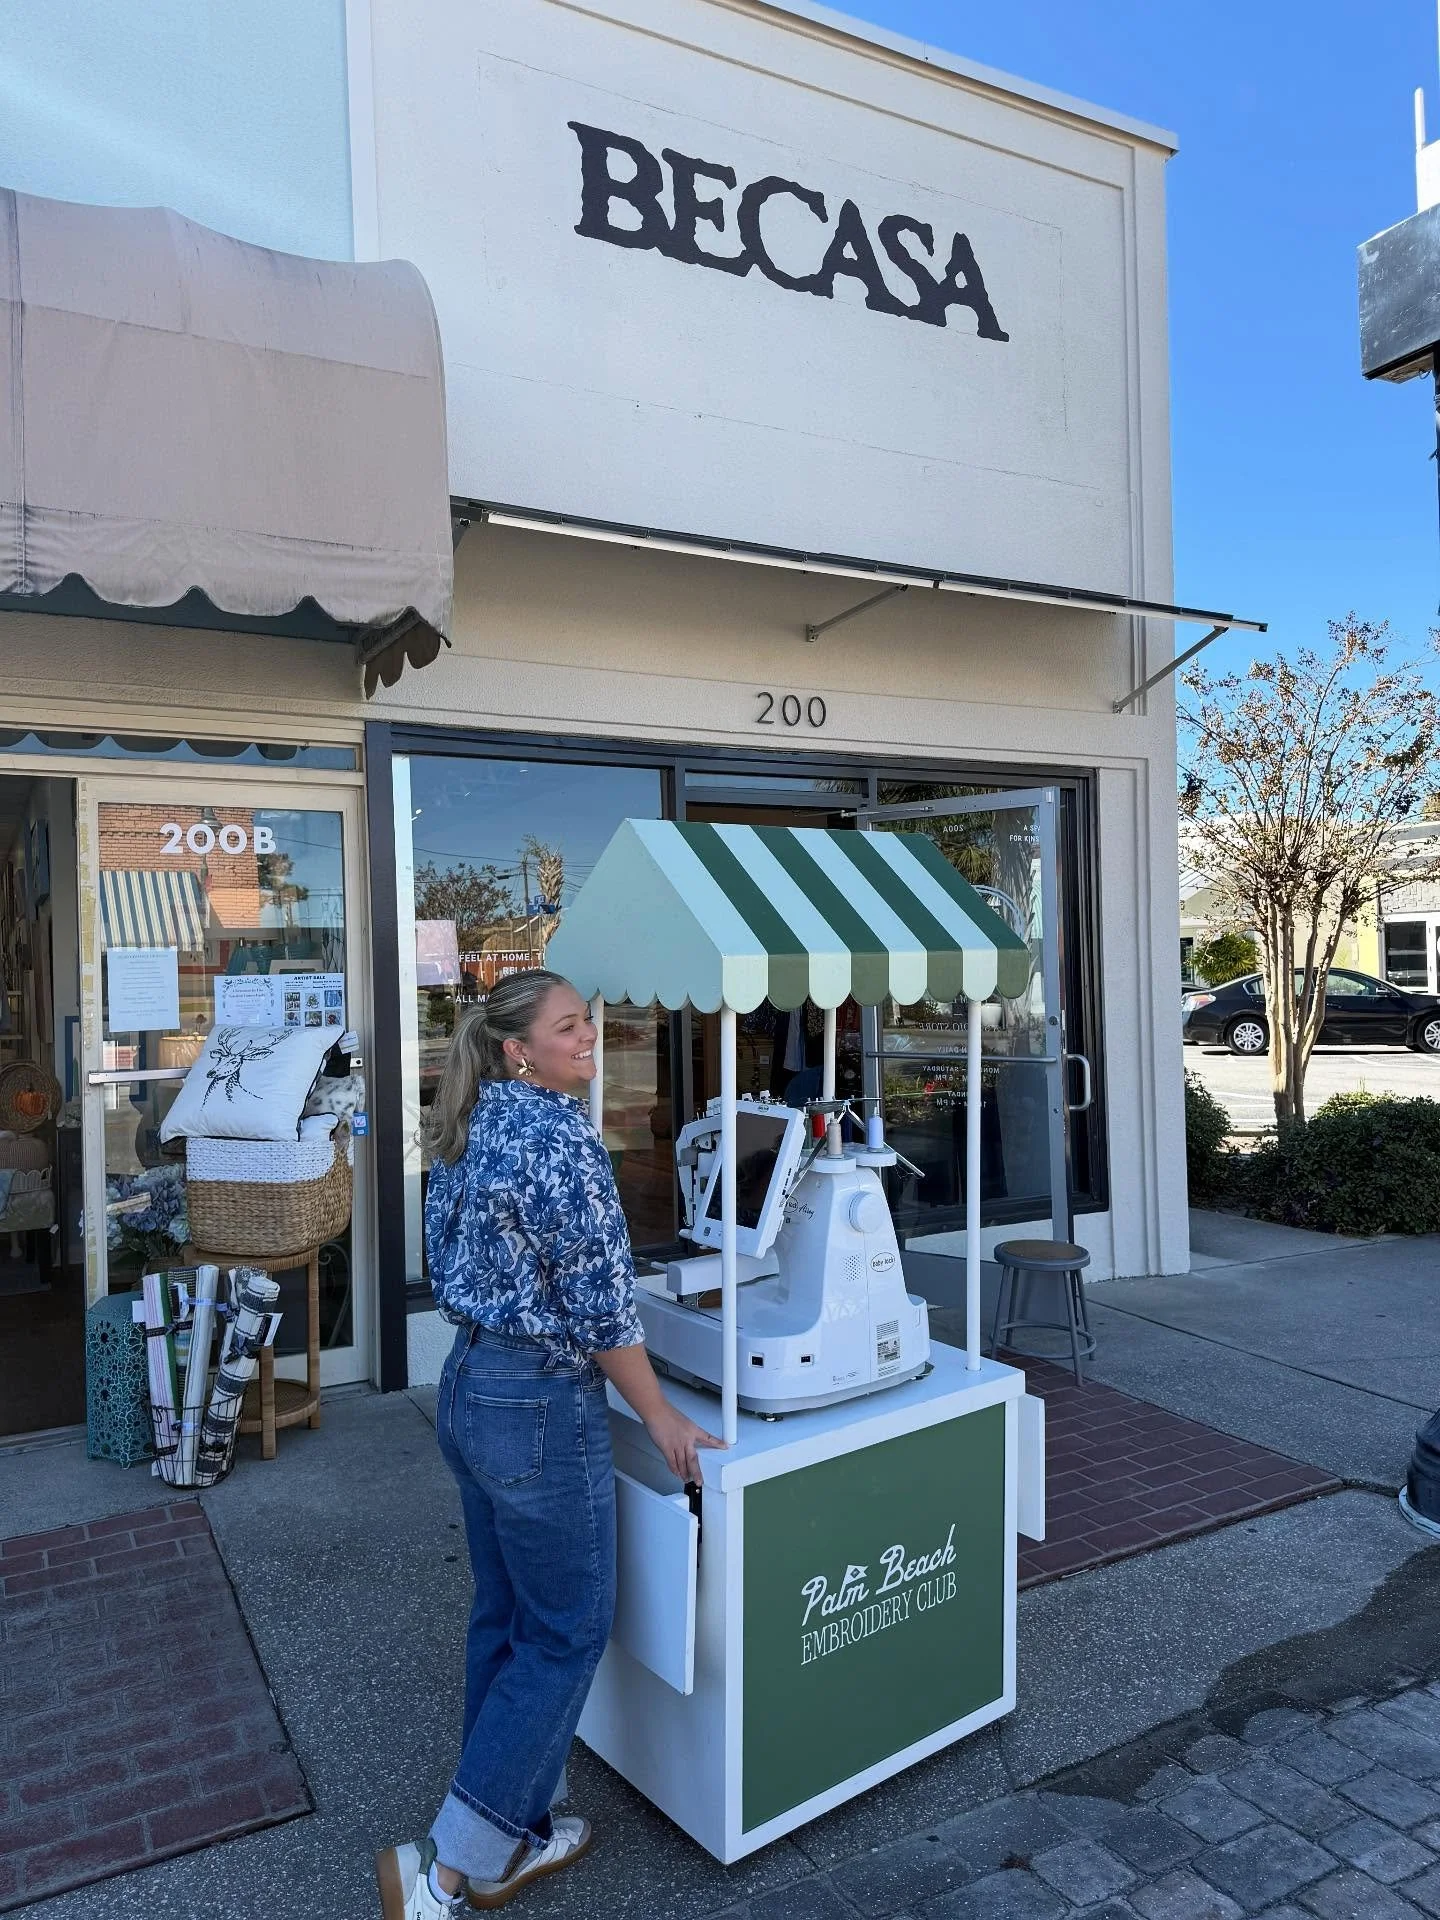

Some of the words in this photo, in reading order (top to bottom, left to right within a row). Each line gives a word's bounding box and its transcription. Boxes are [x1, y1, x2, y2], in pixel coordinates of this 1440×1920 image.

[567, 120, 1009, 342] BECASA
[755, 691, 827, 727] 200
[159, 822, 277, 854] 200B
[1009, 834, 1022, 842] FOR
[459, 953, 483, 963] FEEL
[486, 953, 499, 962] AT
[455, 994, 474, 1004] ALL
[801, 1565, 870, 1627] Palm
[875, 1523, 957, 1595] Beach
[801, 1588, 914, 1666] EMBROIDERY
[916, 1571, 957, 1612] CLUB
